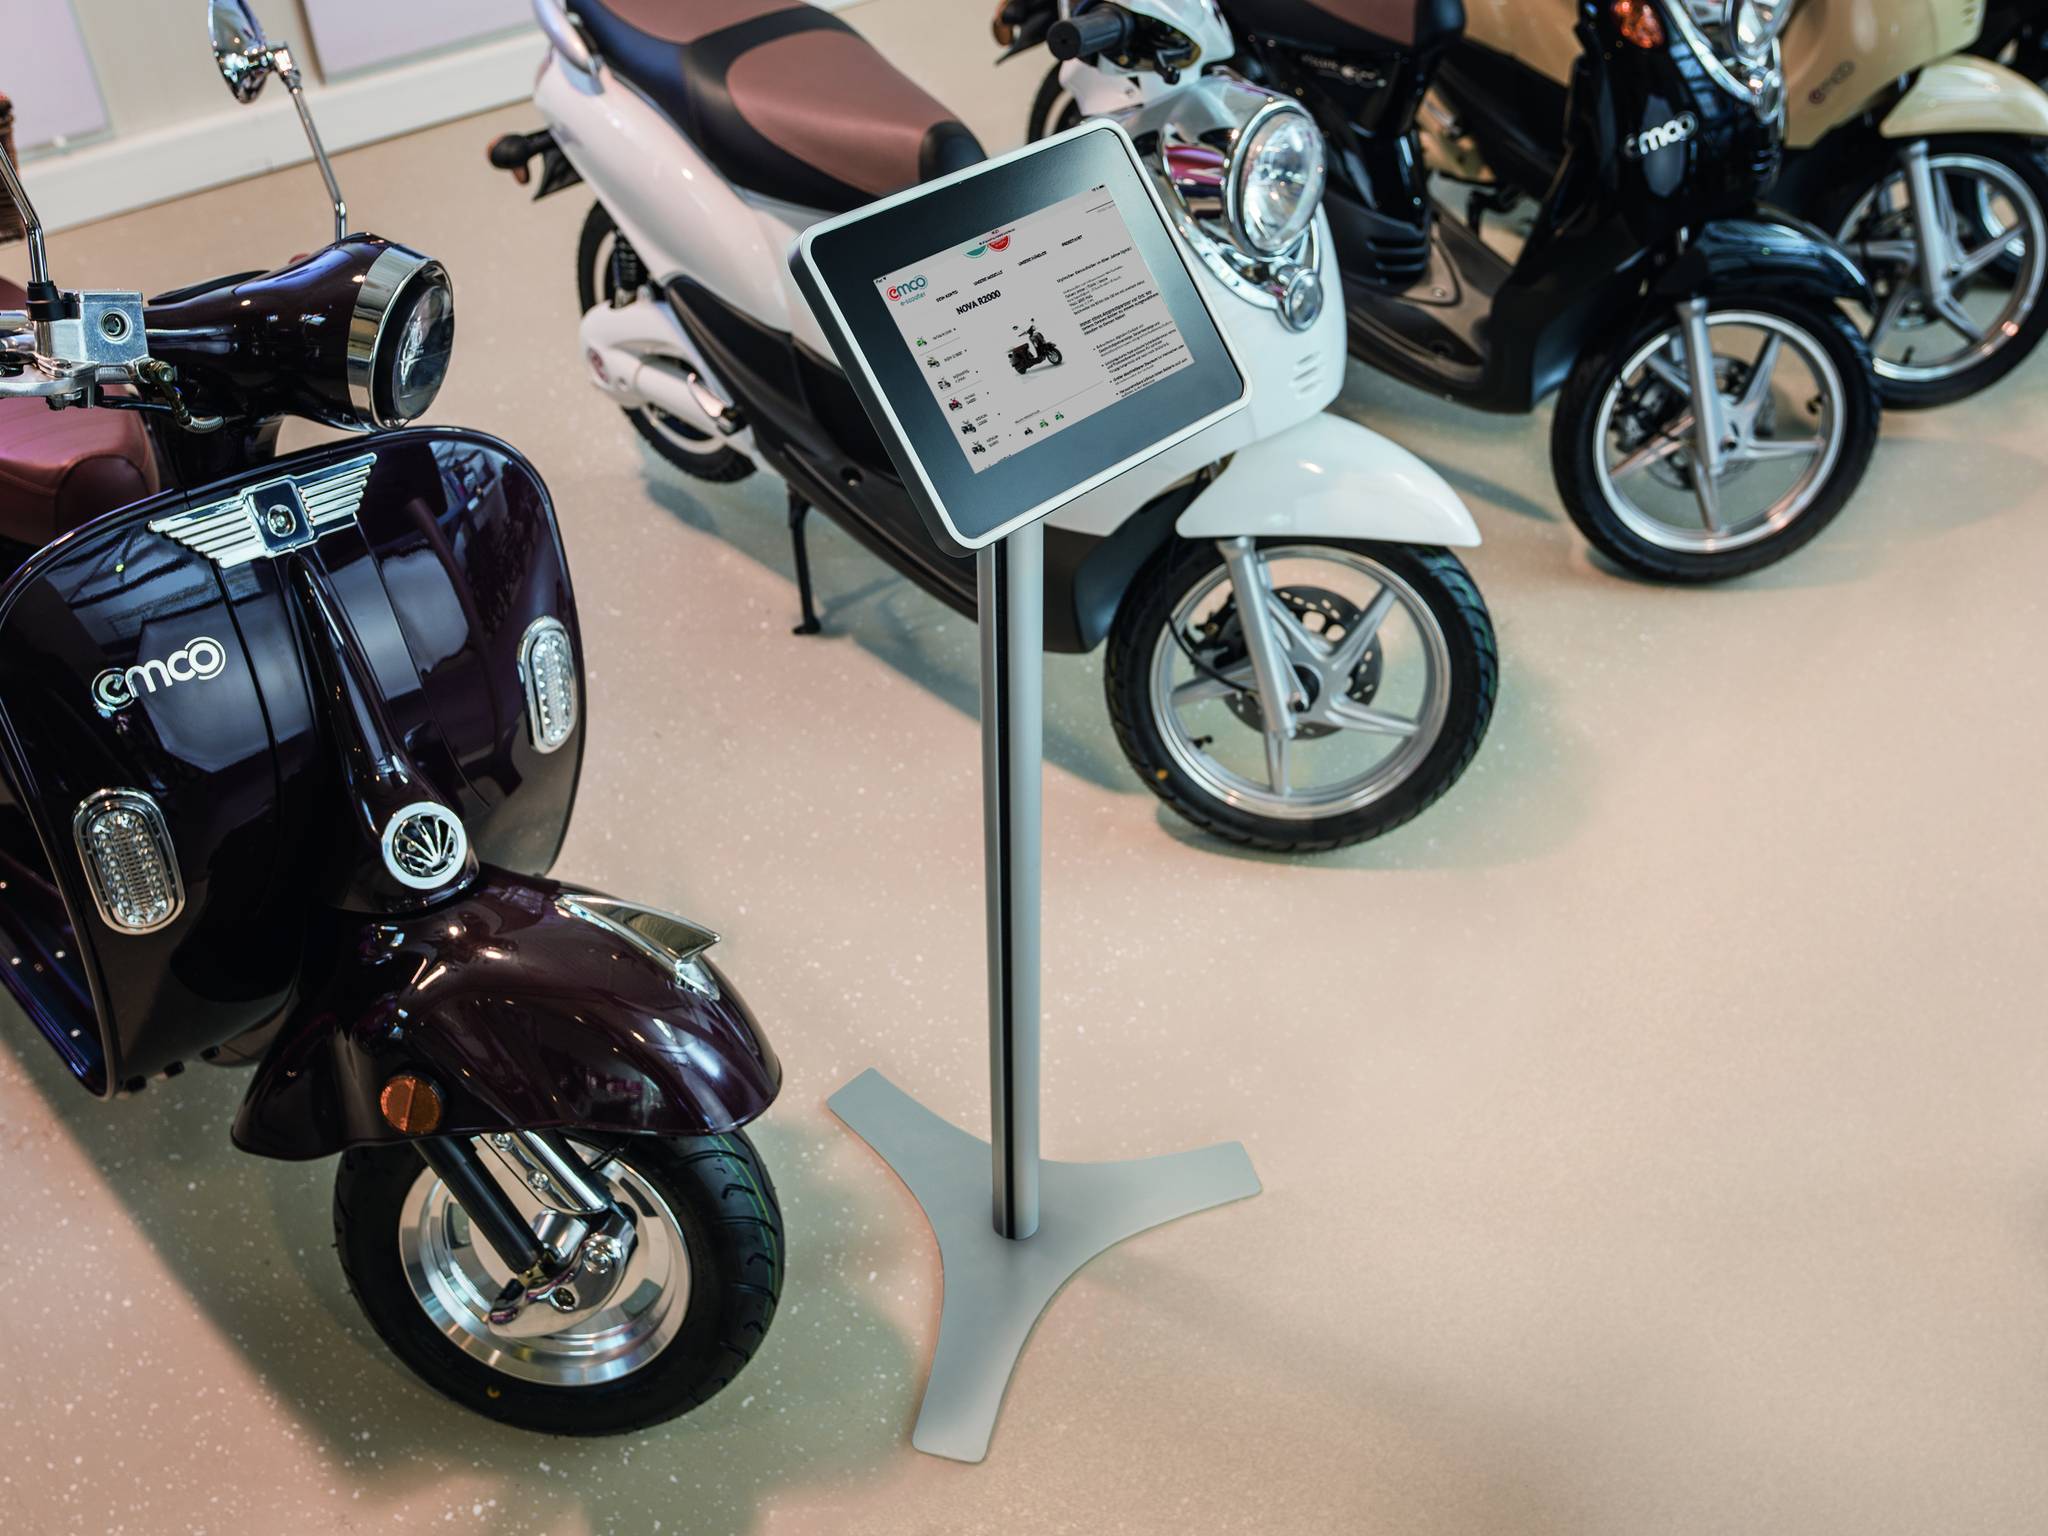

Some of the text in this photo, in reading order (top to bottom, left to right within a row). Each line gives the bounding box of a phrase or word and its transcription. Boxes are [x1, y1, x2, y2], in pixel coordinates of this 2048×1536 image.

[886, 274, 929, 301] emco
[956, 299, 978, 315] NOVA
[977, 289, 1001, 306] R2000
[91, 636, 226, 711] emco
